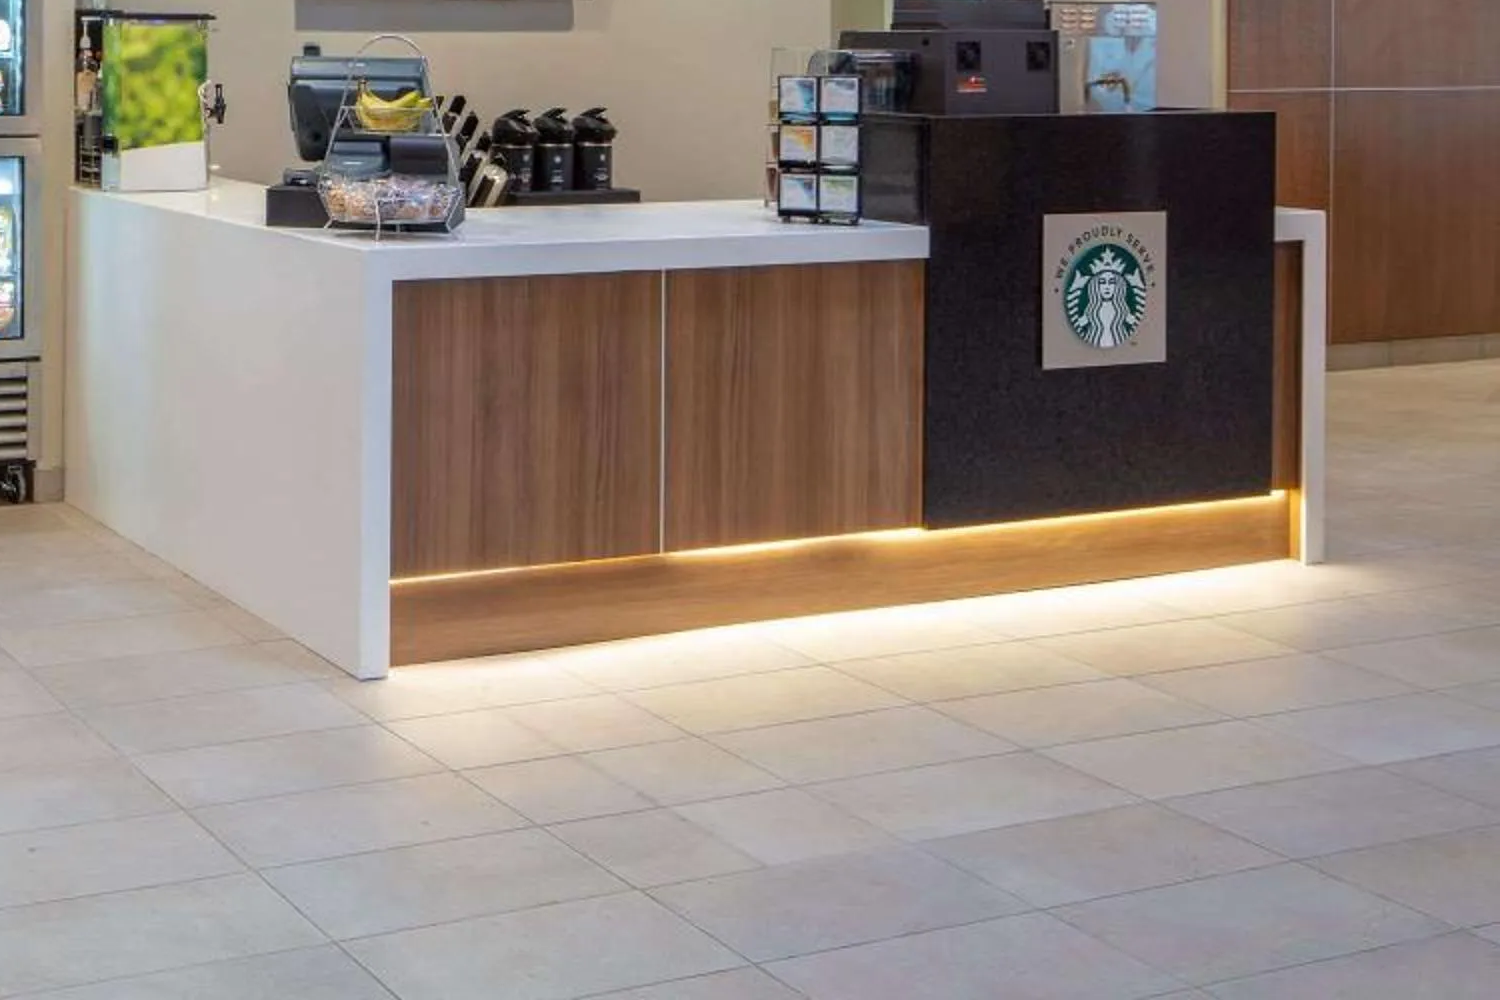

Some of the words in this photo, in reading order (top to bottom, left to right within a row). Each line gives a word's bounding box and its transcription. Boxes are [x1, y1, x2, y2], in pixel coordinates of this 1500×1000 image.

[1055, 257, 1069, 279] WE
[1068, 225, 1123, 255] PROUDLY
[1126, 233, 1155, 273] SERVE
